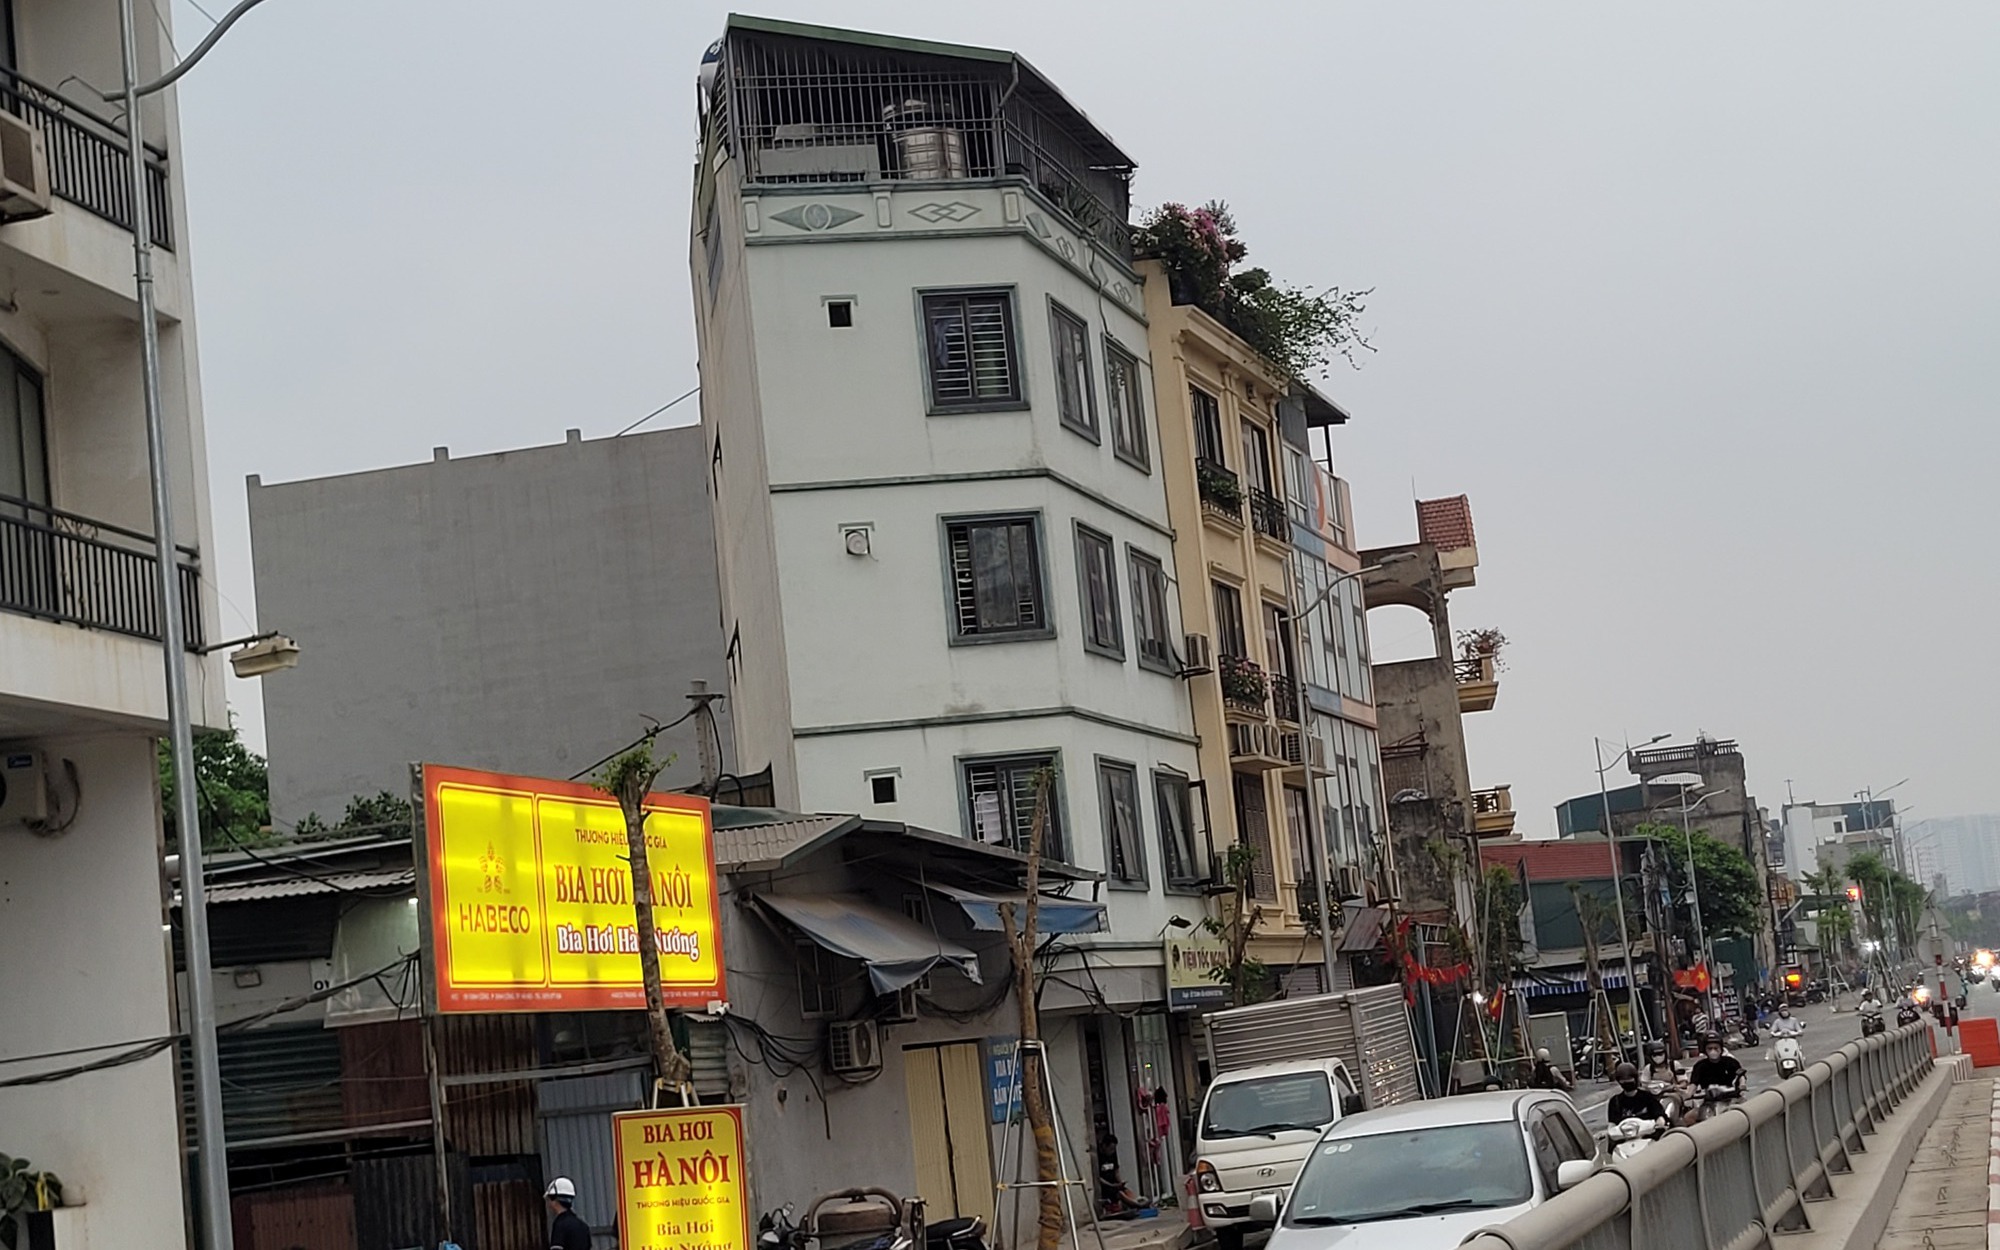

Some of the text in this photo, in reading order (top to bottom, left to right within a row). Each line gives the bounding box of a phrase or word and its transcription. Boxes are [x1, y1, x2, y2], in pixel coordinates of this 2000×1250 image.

[554, 864, 589, 904] BIA
[590, 865, 627, 906] HƠI
[659, 863, 694, 918] NỘI
[458, 902, 531, 934] HABECO
[556, 921, 584, 954] Bia
[586, 922, 615, 954] Hơi
[617, 923, 641, 954] Hà
[643, 1120, 714, 1144] BIA HƠI
[632, 1148, 731, 1191] HÀ NỘI
[716, 1196, 731, 1205] GIA
[657, 1219, 714, 1236] Bia Hơi
